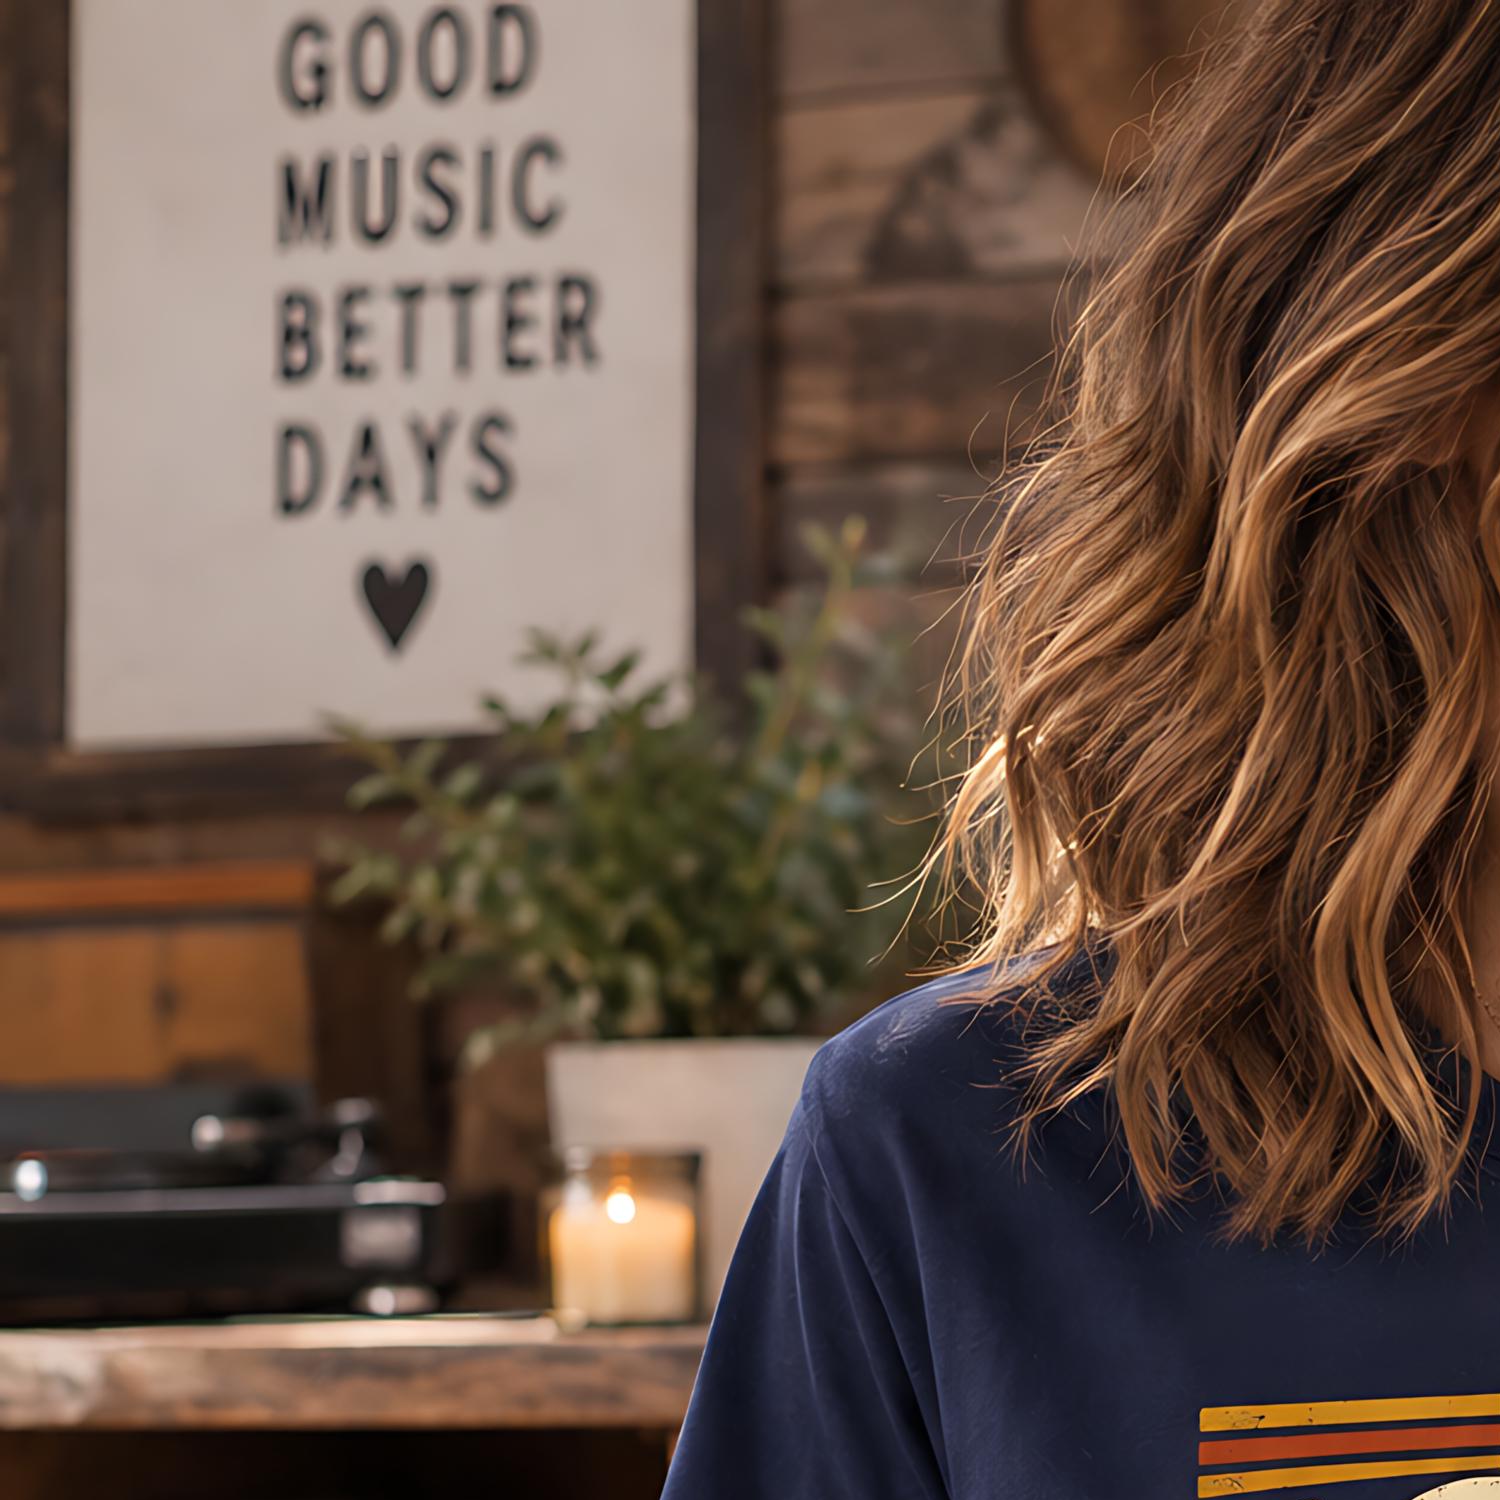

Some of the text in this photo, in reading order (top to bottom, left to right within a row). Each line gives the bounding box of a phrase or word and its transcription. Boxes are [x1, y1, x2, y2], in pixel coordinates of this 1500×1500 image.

[277, 3, 540, 113] GOOD
[276, 136, 566, 252] MUSIC
[275, 272, 602, 386] BETTER
[274, 411, 518, 519] DAYS
